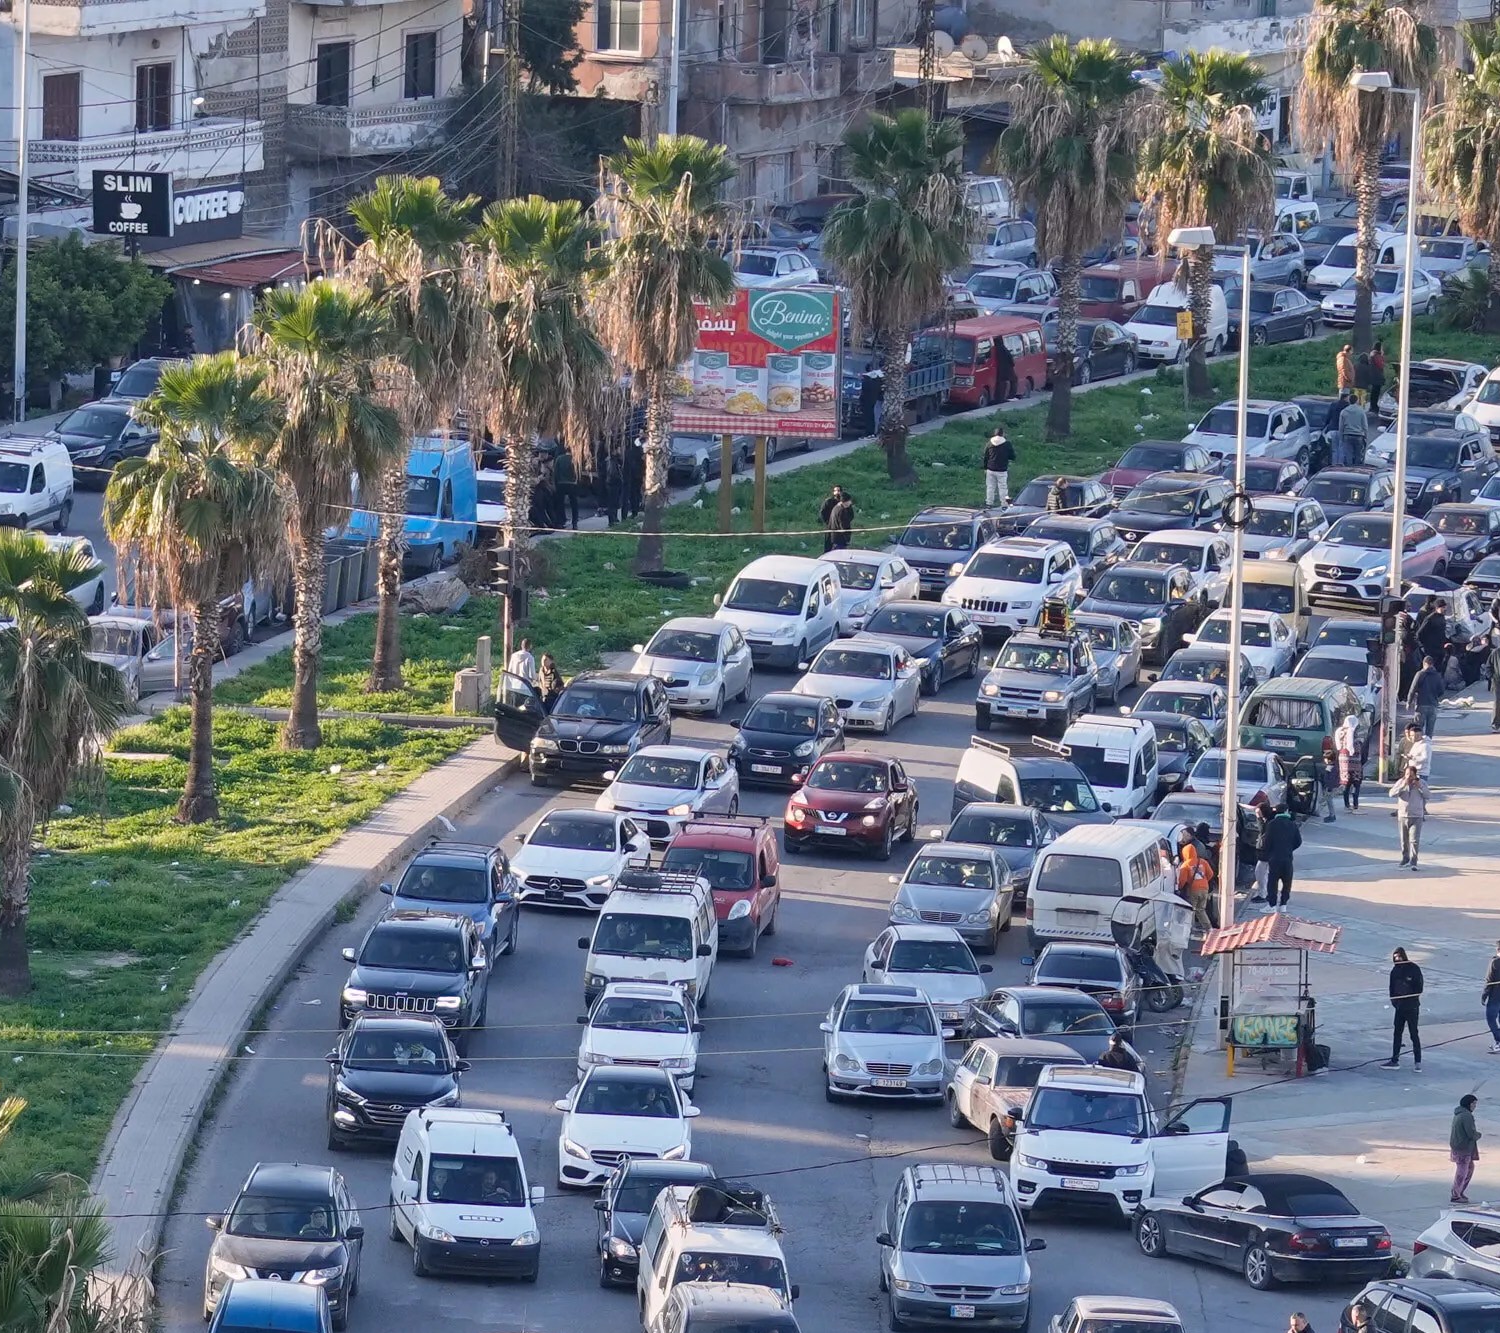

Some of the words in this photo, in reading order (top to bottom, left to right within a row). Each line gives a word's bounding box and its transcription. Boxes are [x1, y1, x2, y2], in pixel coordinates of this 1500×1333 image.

[103, 174, 153, 193] SLIM
[173, 190, 229, 226] COFFEE
[109, 221, 149, 234] COFFEE
[759, 299, 824, 326] Benina
